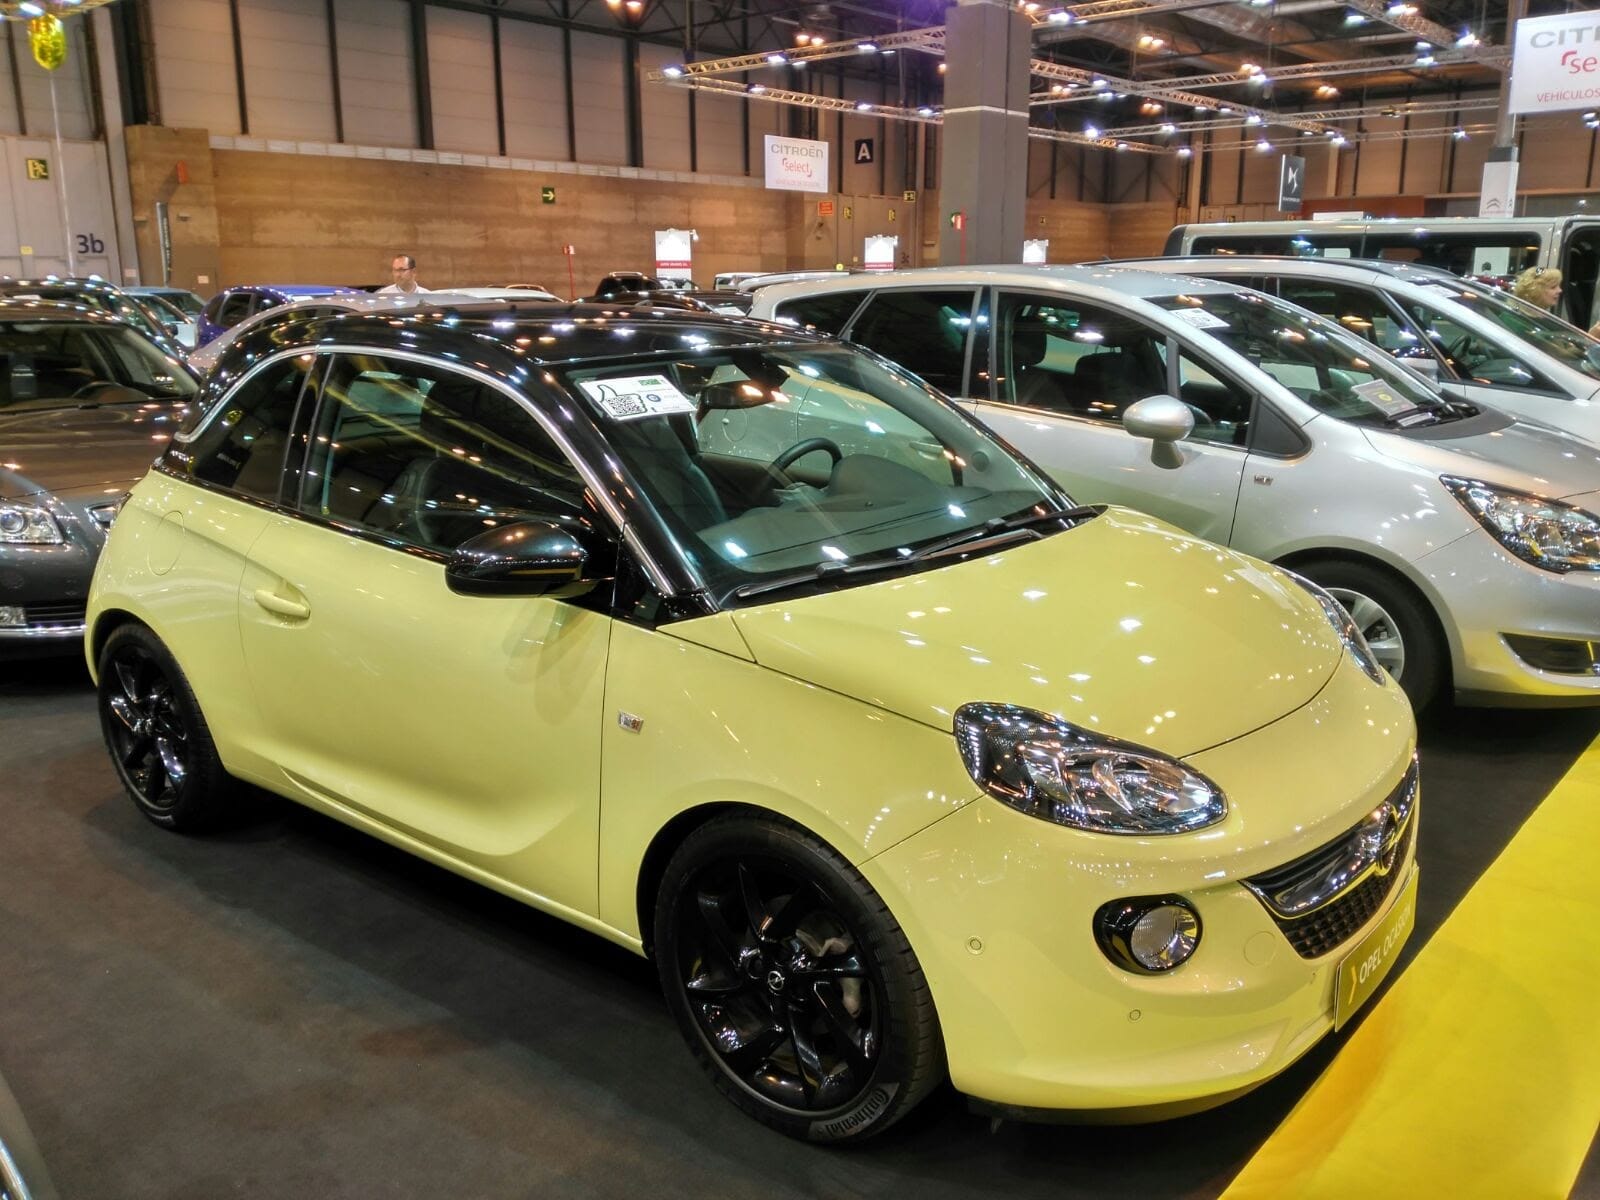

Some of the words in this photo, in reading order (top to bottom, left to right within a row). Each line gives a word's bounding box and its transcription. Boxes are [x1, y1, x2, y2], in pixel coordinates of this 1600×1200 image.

[858, 143, 871, 161] A
[76, 233, 105, 254] 3b
[1359, 946, 1382, 984] OPEL
[825, 1088, 889, 1138] Continental
